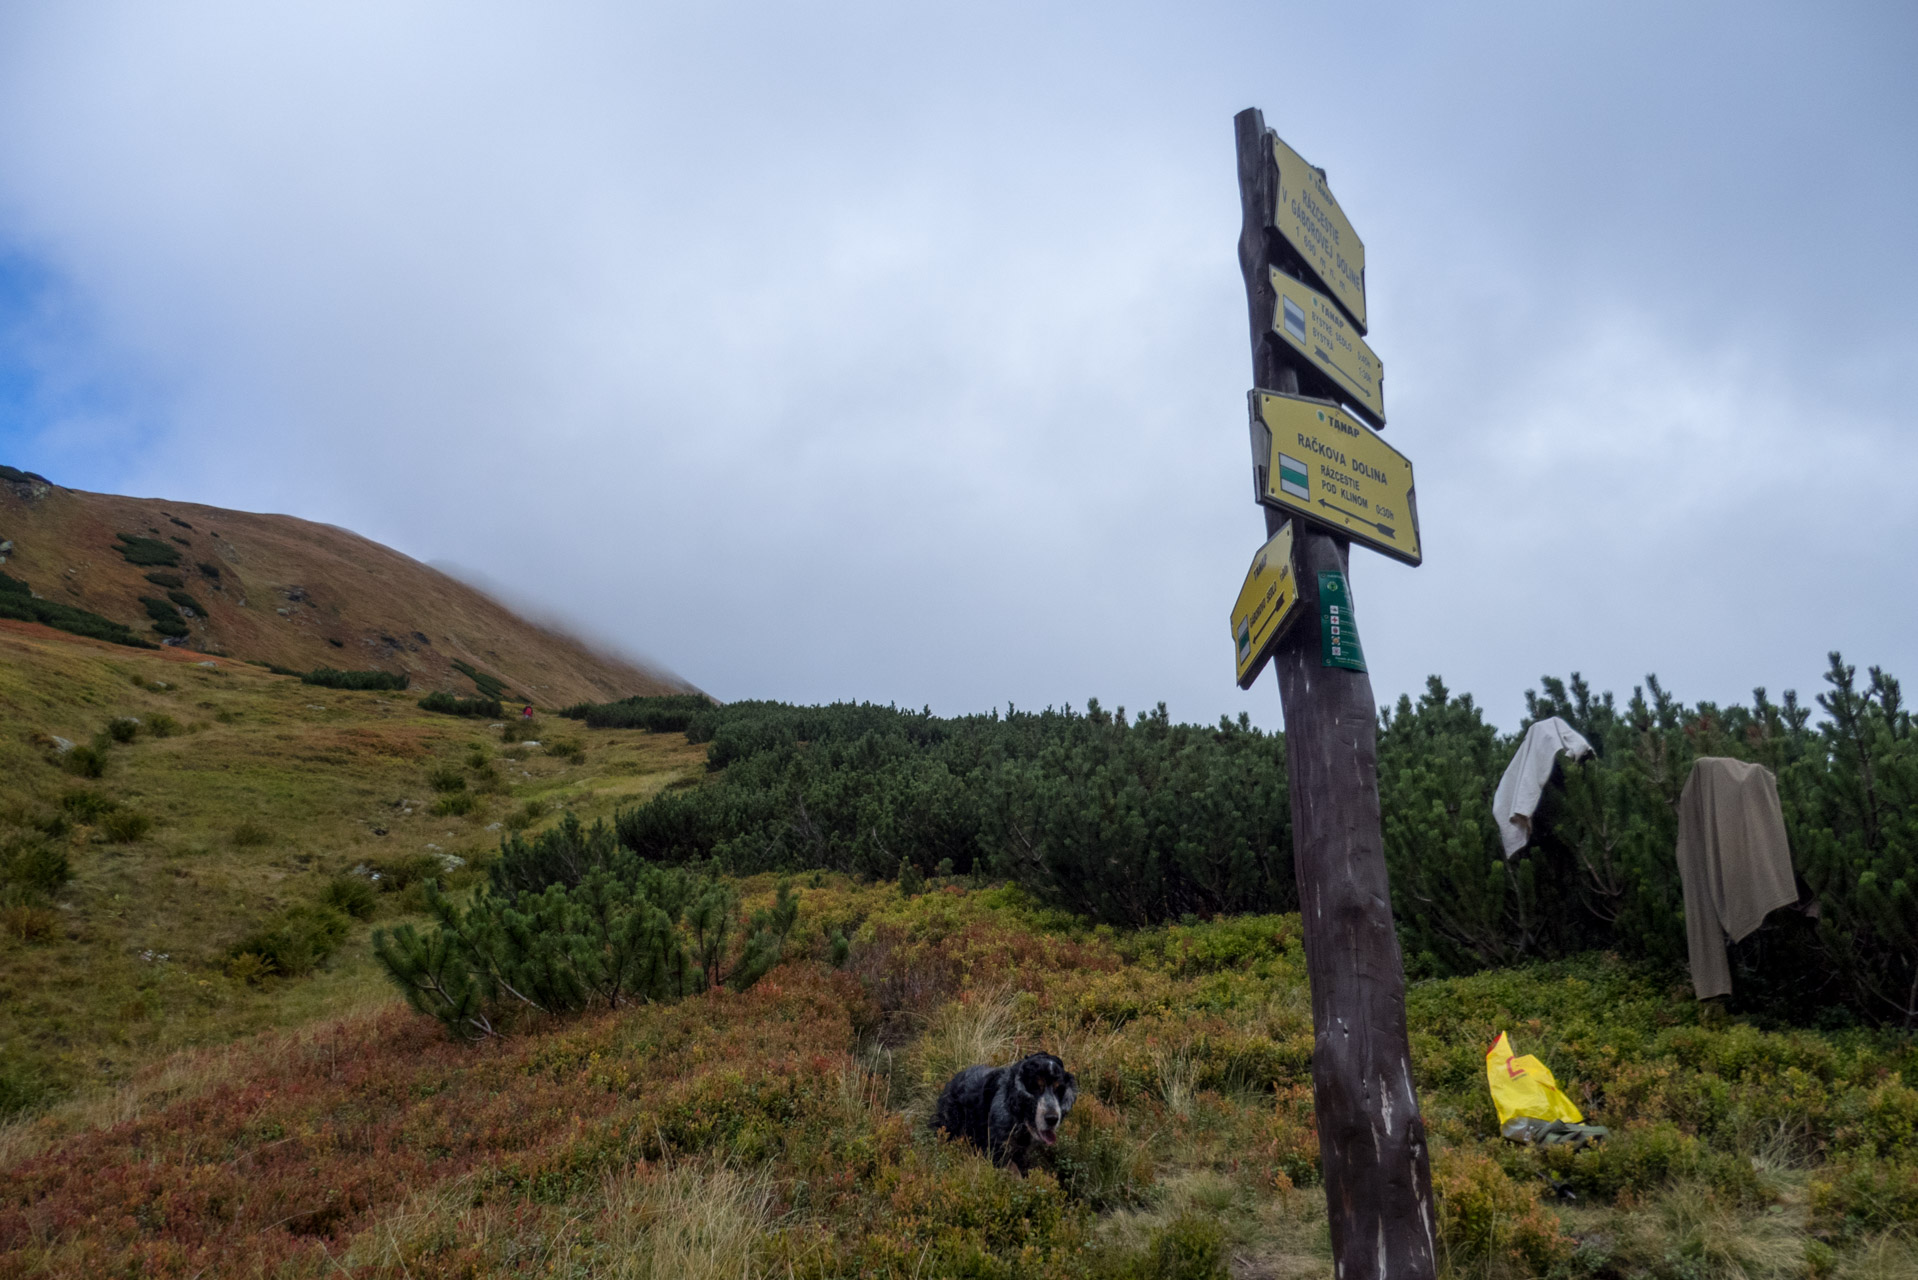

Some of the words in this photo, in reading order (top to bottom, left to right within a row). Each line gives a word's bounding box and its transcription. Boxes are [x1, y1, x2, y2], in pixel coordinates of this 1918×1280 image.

[1302, 189, 1339, 246] RÁZCESTIE
[1282, 186, 1288, 204] V
[1291, 198, 1332, 259] GÁBOROVEJ
[1336, 252, 1361, 293] DOLINE
[1321, 303, 1344, 329] TANAP
[1328, 415, 1360, 438] TANAP
[1298, 432, 1346, 467] RAČKOVA
[1352, 458, 1388, 486] DOLINA
[1320, 464, 1360, 492] RÁZCESTIE
[1322, 480, 1336, 495] POD
[1340, 488, 1368, 509] KLINOM
[1376, 504, 1394, 520] 0:30h
